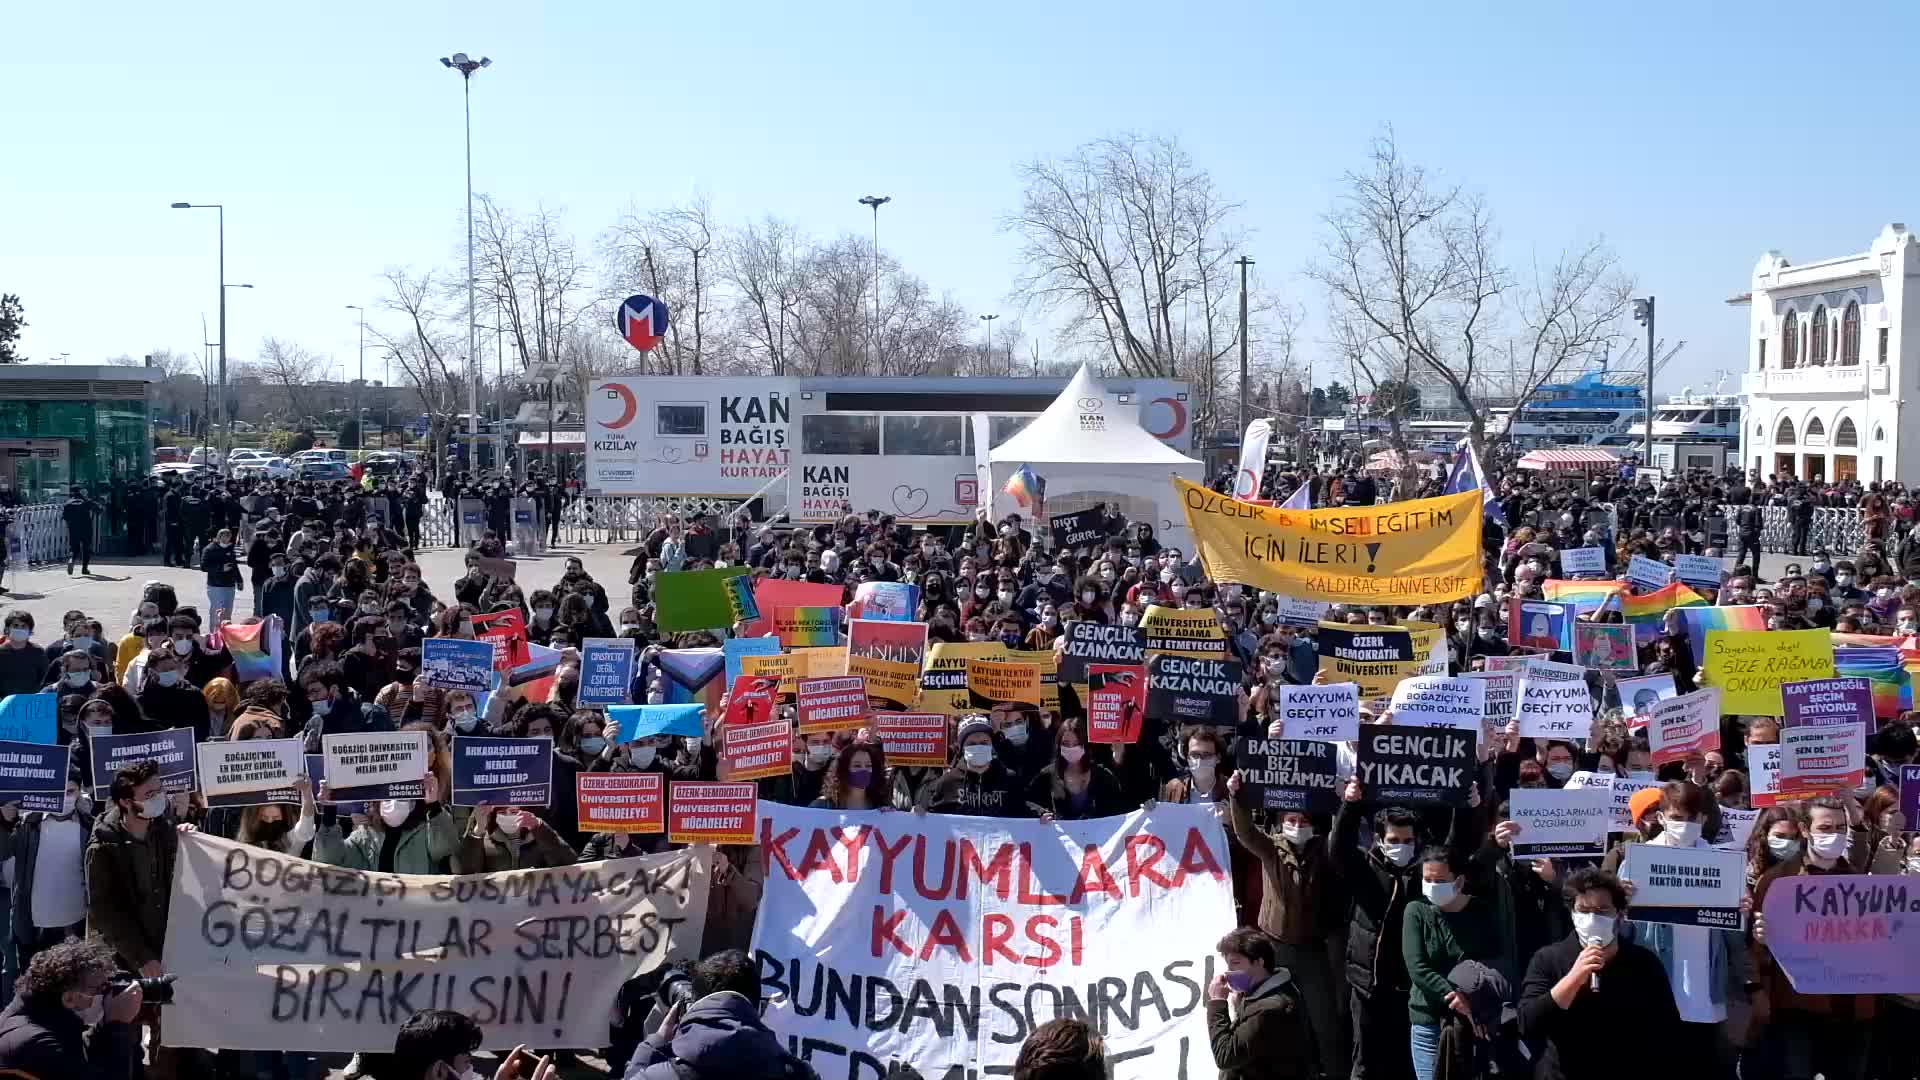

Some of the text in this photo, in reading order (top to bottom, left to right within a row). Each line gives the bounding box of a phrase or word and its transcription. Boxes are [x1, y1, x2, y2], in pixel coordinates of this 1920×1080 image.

[720, 397, 790, 424] KAN
[594, 441, 637, 451] KIZILAY
[721, 449, 790, 464] HAYAT
[804, 466, 849, 484] KAN
[804, 484, 849, 499] BAĞIŞI
[1377, 510, 1453, 535] EĞİTİM
[1245, 532, 1285, 562] İÇİN
[1389, 576, 1467, 595] ÜNİVERSİTE
[1074, 623, 1138, 645] GENÇLİK
[1155, 627, 1211, 638] TEK ADAMA
[1147, 637, 1225, 651] İAT ETMEYECEK!
[1353, 634, 1384, 648] ÖZERK
[1335, 646, 1400, 660] DEMOKRATİK
[933, 658, 966, 668] KAYYU
[1161, 660, 1225, 678] GENÇLİK
[1337, 662, 1398, 675] ÜNİVERSİTE!
[1150, 675, 1241, 696] KAZANACAK
[1410, 682, 1468, 692] MELİH BULU
[1786, 679, 1866, 695] KAYYIM DEĞİL
[1288, 692, 1353, 704] KAYYUMA
[1407, 692, 1470, 704] BOĞAZİÇİ'YE
[1525, 688, 1586, 699] KAYYUMA
[1809, 690, 1844, 703] SEÇİM
[1287, 706, 1354, 720] GEÇİT YOK
[1396, 702, 1480, 716] REKTÖR OLAMAZ
[1522, 702, 1591, 717] GEÇİT YOK
[1799, 703, 1857, 714] İSTİYORUZ
[1316, 726, 1338, 735] FKF
[1550, 722, 1573, 730] FKF
[152, 740, 176, 752] DEĞİL
[1248, 740, 1327, 757] BASKILAR
[1373, 735, 1466, 759] GENÇLİK
[485, 760, 517, 771] NEREDE
[1267, 755, 1299, 772] BİZİ
[0, 765, 56, 779] İSTEMİYORUZ
[1239, 767, 1335, 788] YILDIRAMAZ
[1360, 761, 1463, 788] YIKACAK
[590, 807, 648, 819] MÜCADELEYE!
[672, 804, 752, 813] ÜNİVERSİTE İÇİN
[1516, 808, 1603, 818] ARKADAŞLARIMIZA
[681, 817, 742, 830] MÜCADELEYE!
[760, 818, 1225, 905] KAYYUMLARA
[1650, 863, 1721, 878] MELİH BULU BİZE
[430, 861, 692, 907] SUSMAYACAK!
[1649, 876, 1682, 888] REKTÖR
[1697, 910, 1738, 919] ÖĞRENCİ
[202, 896, 686, 963] GÖZALTILAR SERBEST
[872, 904, 1083, 975] KARŞI
[272, 966, 572, 1038] BIRAKILSIN!
[755, 949, 1215, 1045] BUNDAN SONRASI
